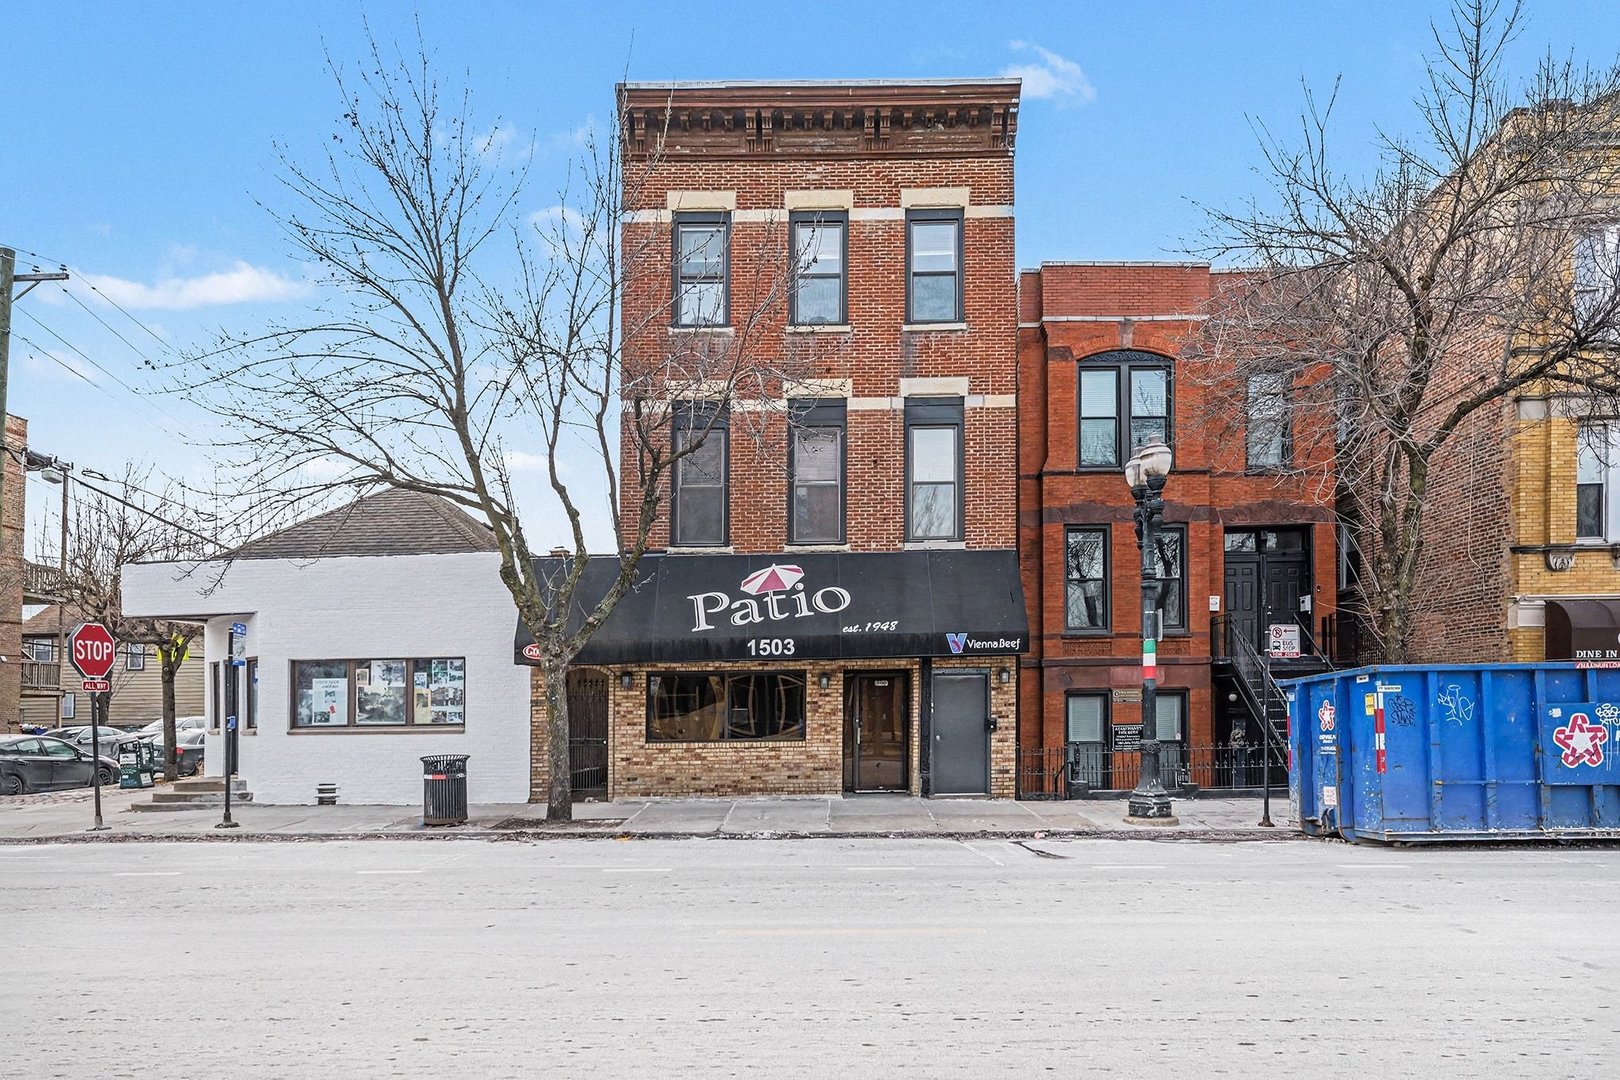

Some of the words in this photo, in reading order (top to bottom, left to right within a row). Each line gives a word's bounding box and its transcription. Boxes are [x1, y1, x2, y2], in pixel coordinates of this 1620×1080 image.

[686, 582, 851, 632] Patio
[842, 623, 862, 633] est.
[864, 620, 899, 633] 1948
[76, 639, 112, 661] STOP
[747, 638, 795, 656] 1503
[966, 639, 998, 649] Vienna
[998, 638, 1021, 650] Beef
[1576, 650, 1602, 658] DINE
[1605, 650, 1617, 658] IN
